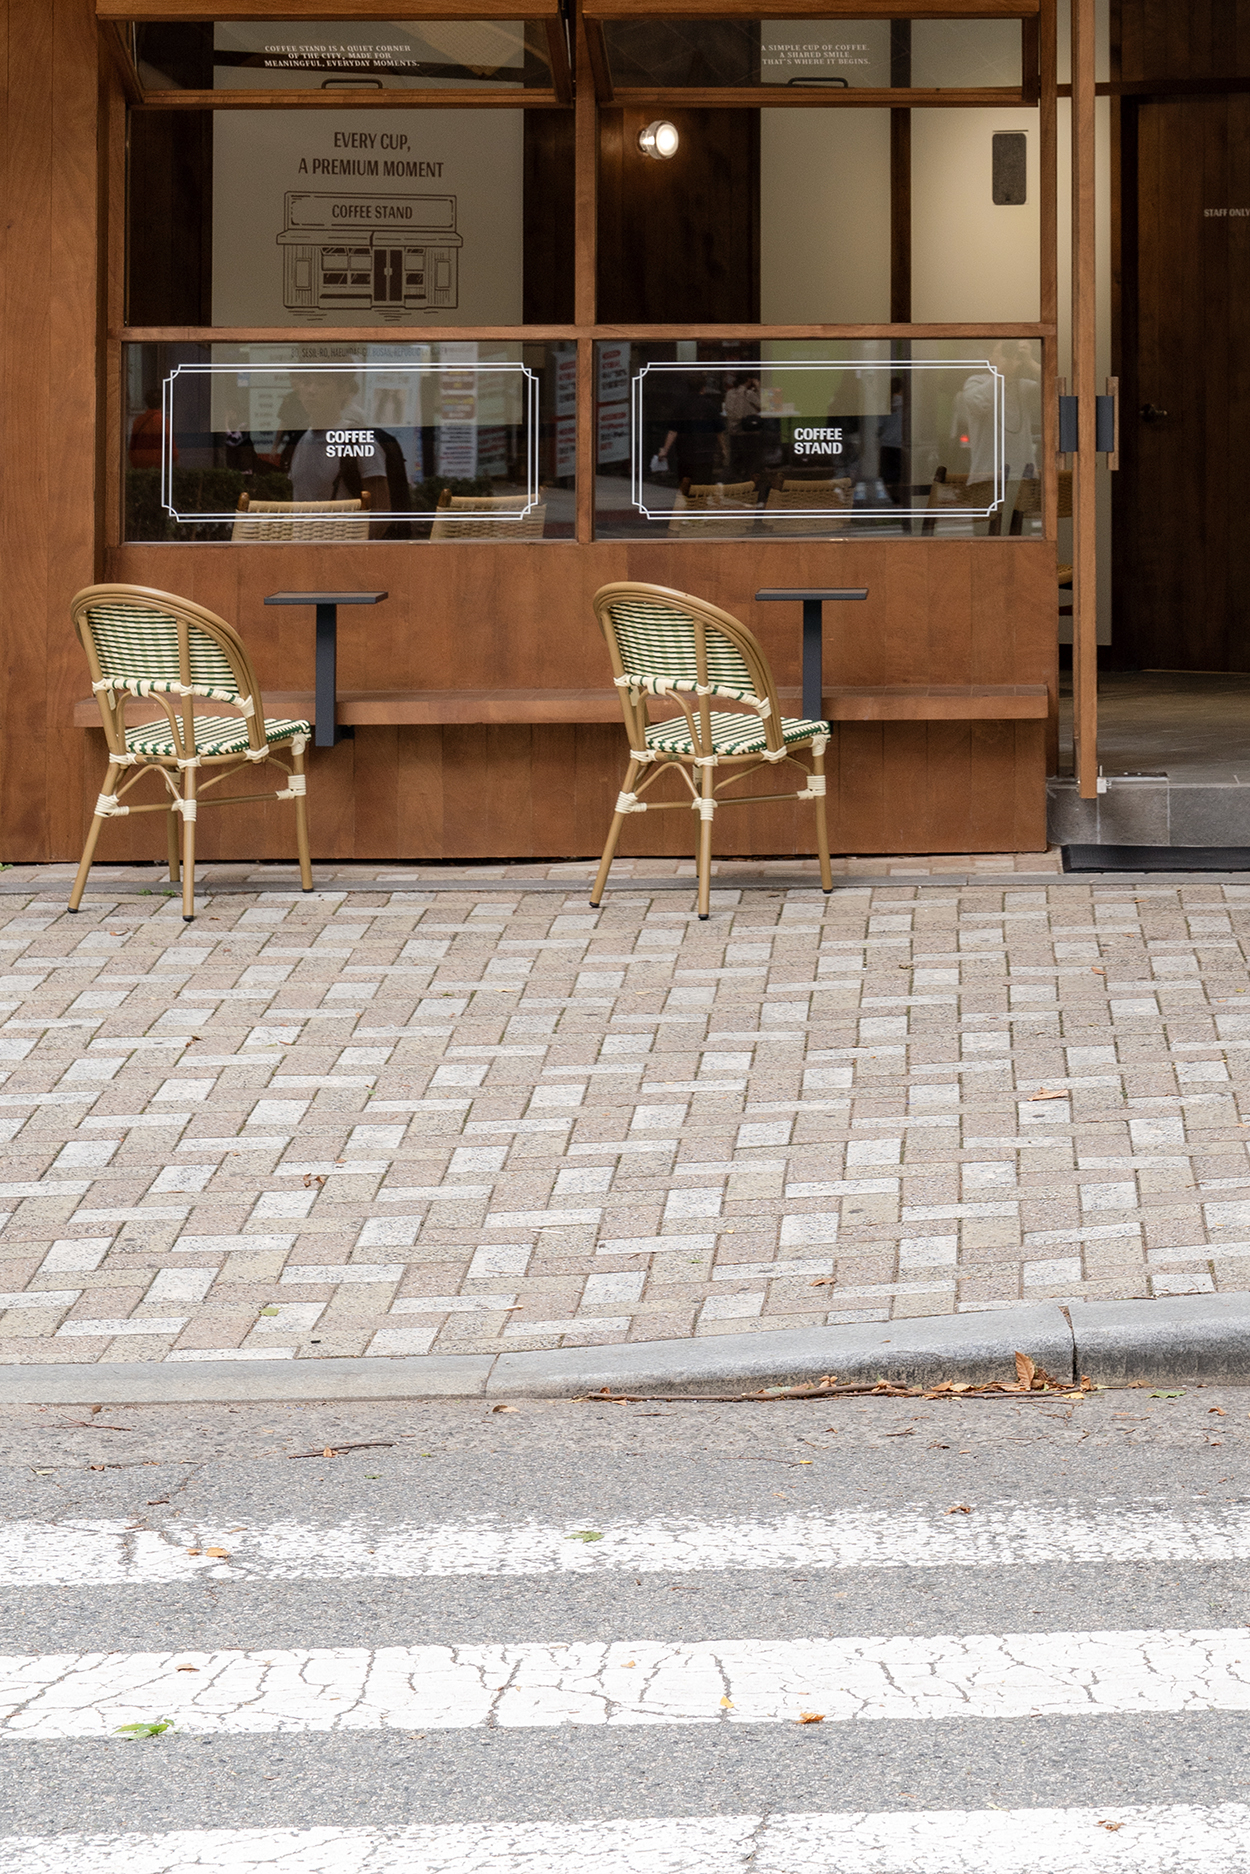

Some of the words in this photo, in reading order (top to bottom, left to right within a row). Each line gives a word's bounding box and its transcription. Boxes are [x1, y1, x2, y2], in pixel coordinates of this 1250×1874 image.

[333, 131, 377, 148] EVERY
[380, 133, 411, 153] CUP,
[298, 158, 308, 174] A
[312, 158, 379, 176] PREMIUM
[383, 160, 444, 178] MOMENT
[332, 204, 372, 219] COFFEE
[375, 205, 413, 220] STAND
[1203, 208, 1228, 217] STAFF
[1229, 208, 1250, 217] ONLY
[325, 430, 375, 444] COFFEE
[794, 428, 842, 441] COFFEE
[325, 445, 375, 458] STAND
[794, 442, 842, 455] STAND
